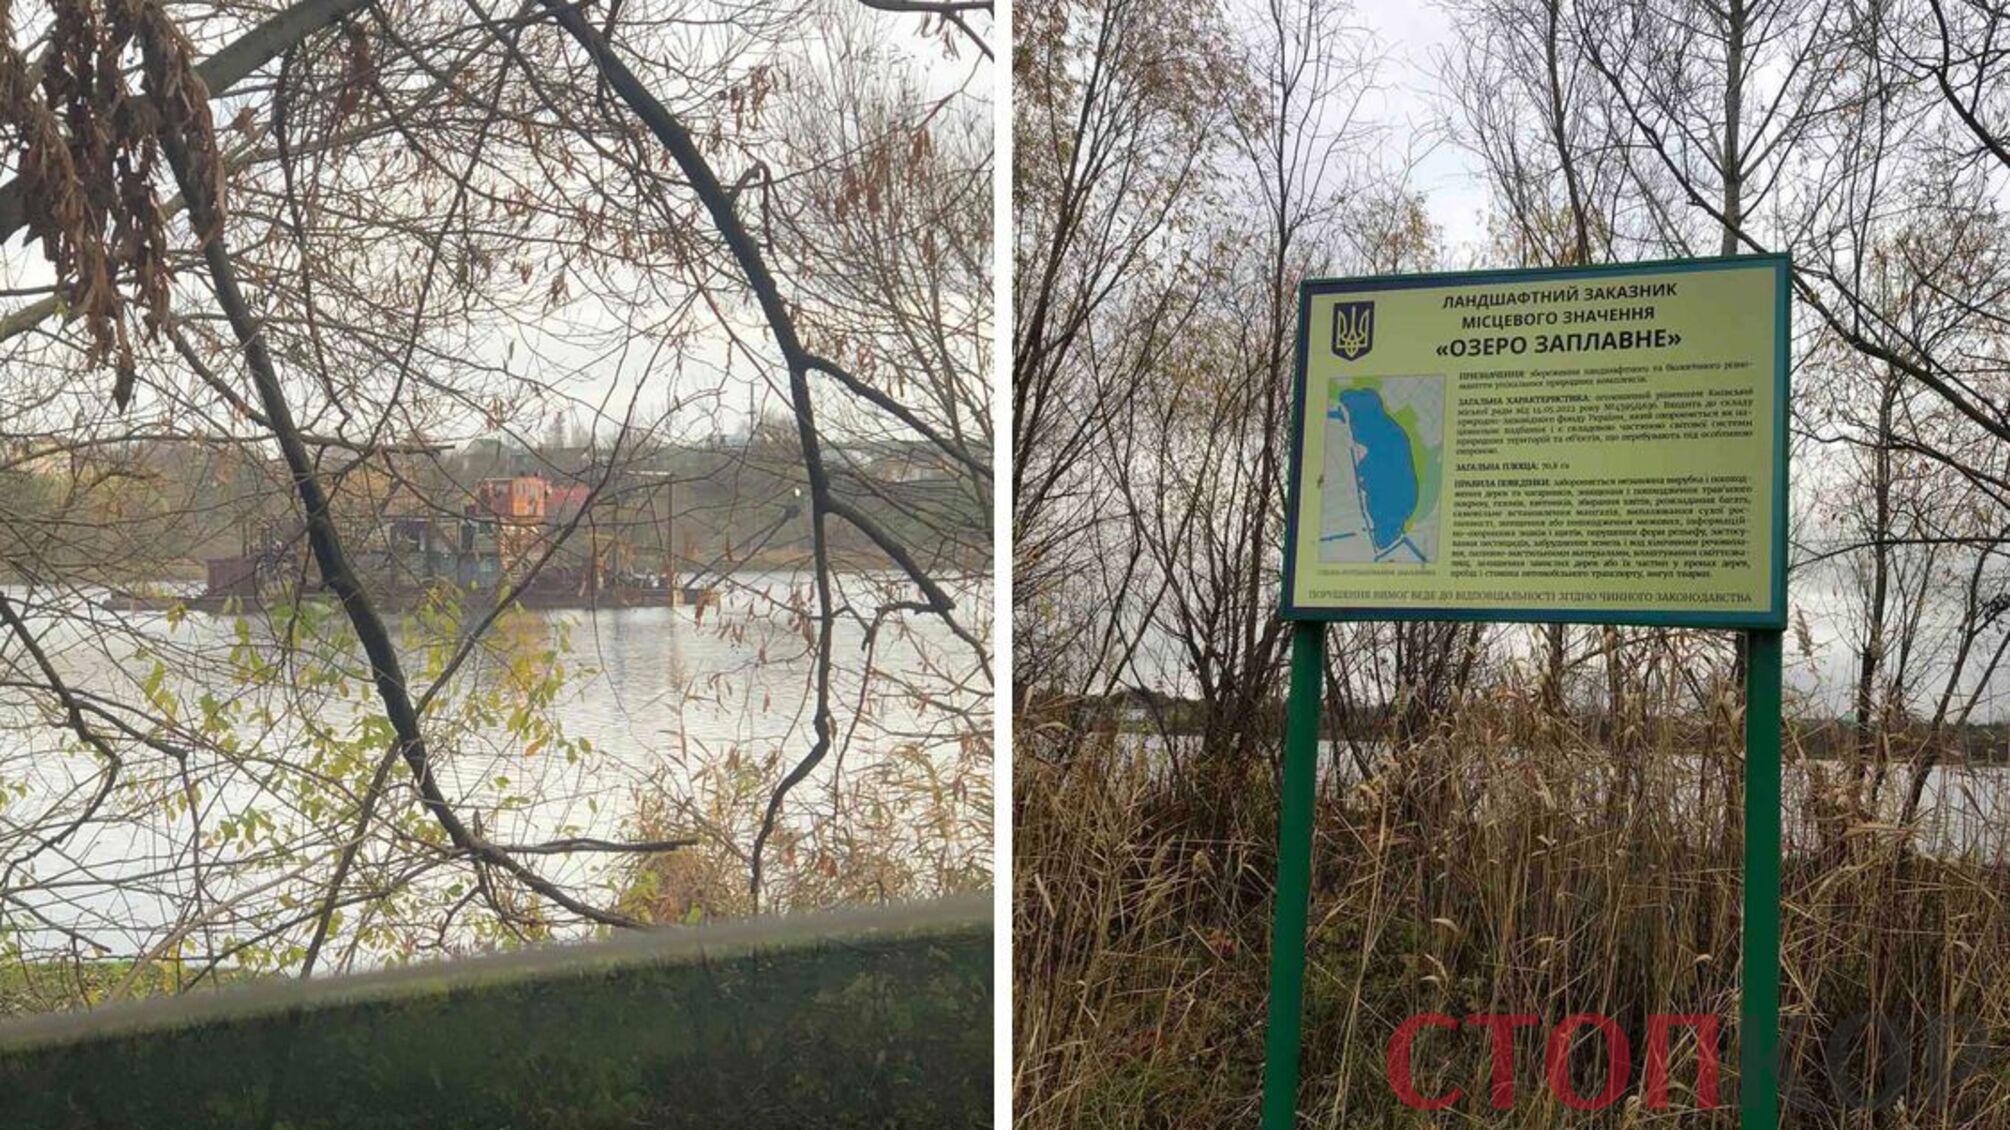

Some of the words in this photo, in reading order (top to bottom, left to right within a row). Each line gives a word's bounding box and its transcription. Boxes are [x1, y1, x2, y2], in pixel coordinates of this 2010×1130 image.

[1443, 286, 1580, 310] ЛАНДШАФТНИЙ
[1584, 282, 1678, 302] ЗАКАЗНИК
[1461, 311, 1559, 331] МІСЦЕВОГО
[1563, 306, 1656, 325] ЗНАЧЕННЯ
[1436, 337, 1528, 358] «ОЗЕРО
[1534, 328, 1683, 354] ЗАПЛАВНЕ»
[1455, 462, 1500, 471] ЗАГАЛЬНА
[1373, 590, 1408, 600] ВИМОГ
[1411, 590, 1436, 600] ВЕДЕ
[1438, 591, 1453, 602] ДО
[1455, 590, 1556, 602] ВІДПОВІДАЛЬНОСТІ
[1558, 592, 1597, 603] ЗГІДНО
[1599, 592, 1654, 602] ЧИННОГО
[1656, 592, 1752, 603] ЗАКОНОДАВСТВА
